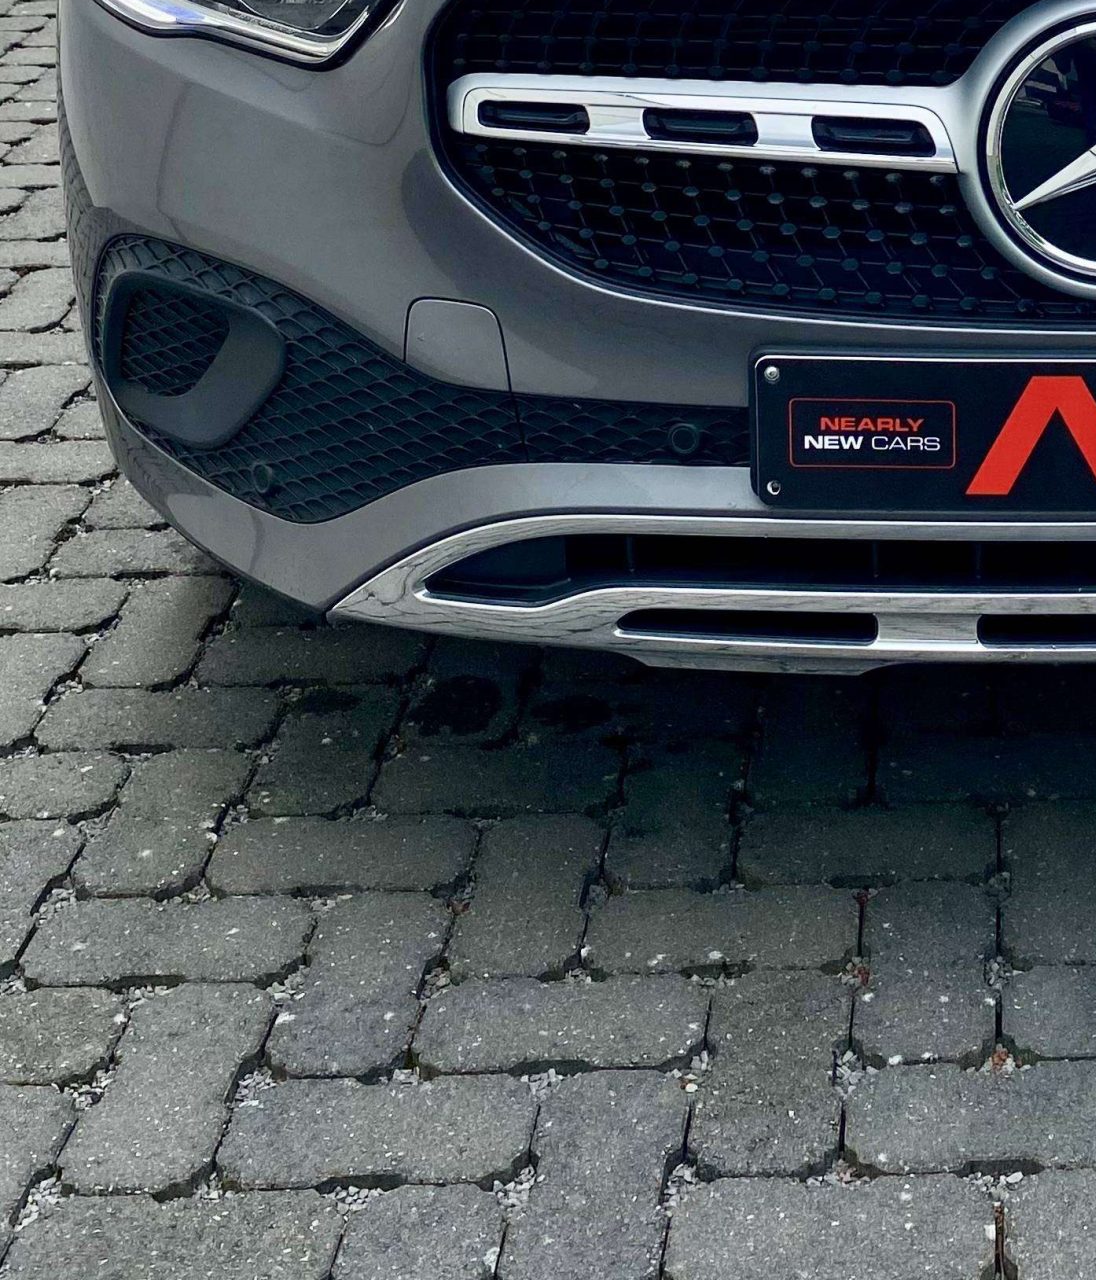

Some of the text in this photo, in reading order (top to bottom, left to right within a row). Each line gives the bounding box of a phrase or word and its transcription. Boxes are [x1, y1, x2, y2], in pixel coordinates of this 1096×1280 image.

[820, 417, 924, 432] NEARLY
[804, 435, 941, 451] NEW CARS
